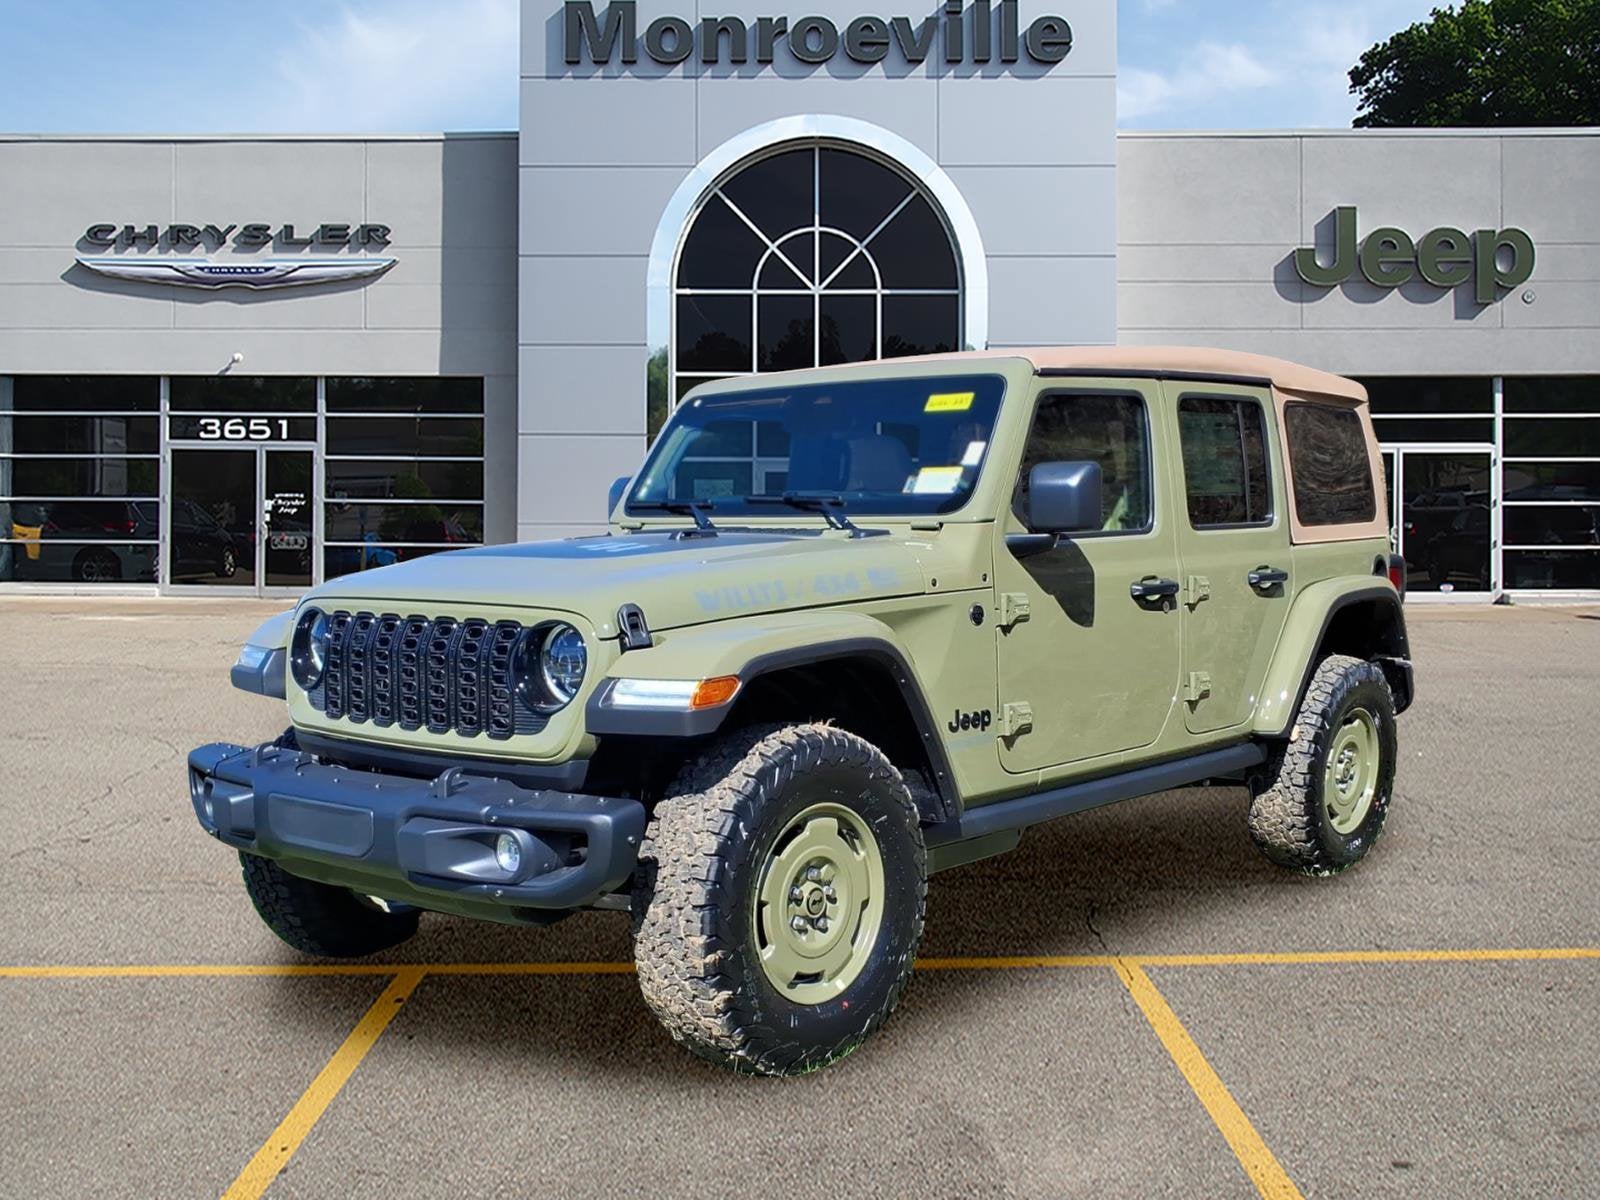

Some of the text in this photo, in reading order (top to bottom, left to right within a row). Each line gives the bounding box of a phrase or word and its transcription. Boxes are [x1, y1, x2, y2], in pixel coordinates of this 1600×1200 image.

[563, 0, 1073, 64] Monroeville
[85, 224, 392, 246] CHRYSLER
[1294, 206, 1536, 304] Jeep
[199, 418, 289, 440] 3651
[948, 709, 991, 733] Jeep
